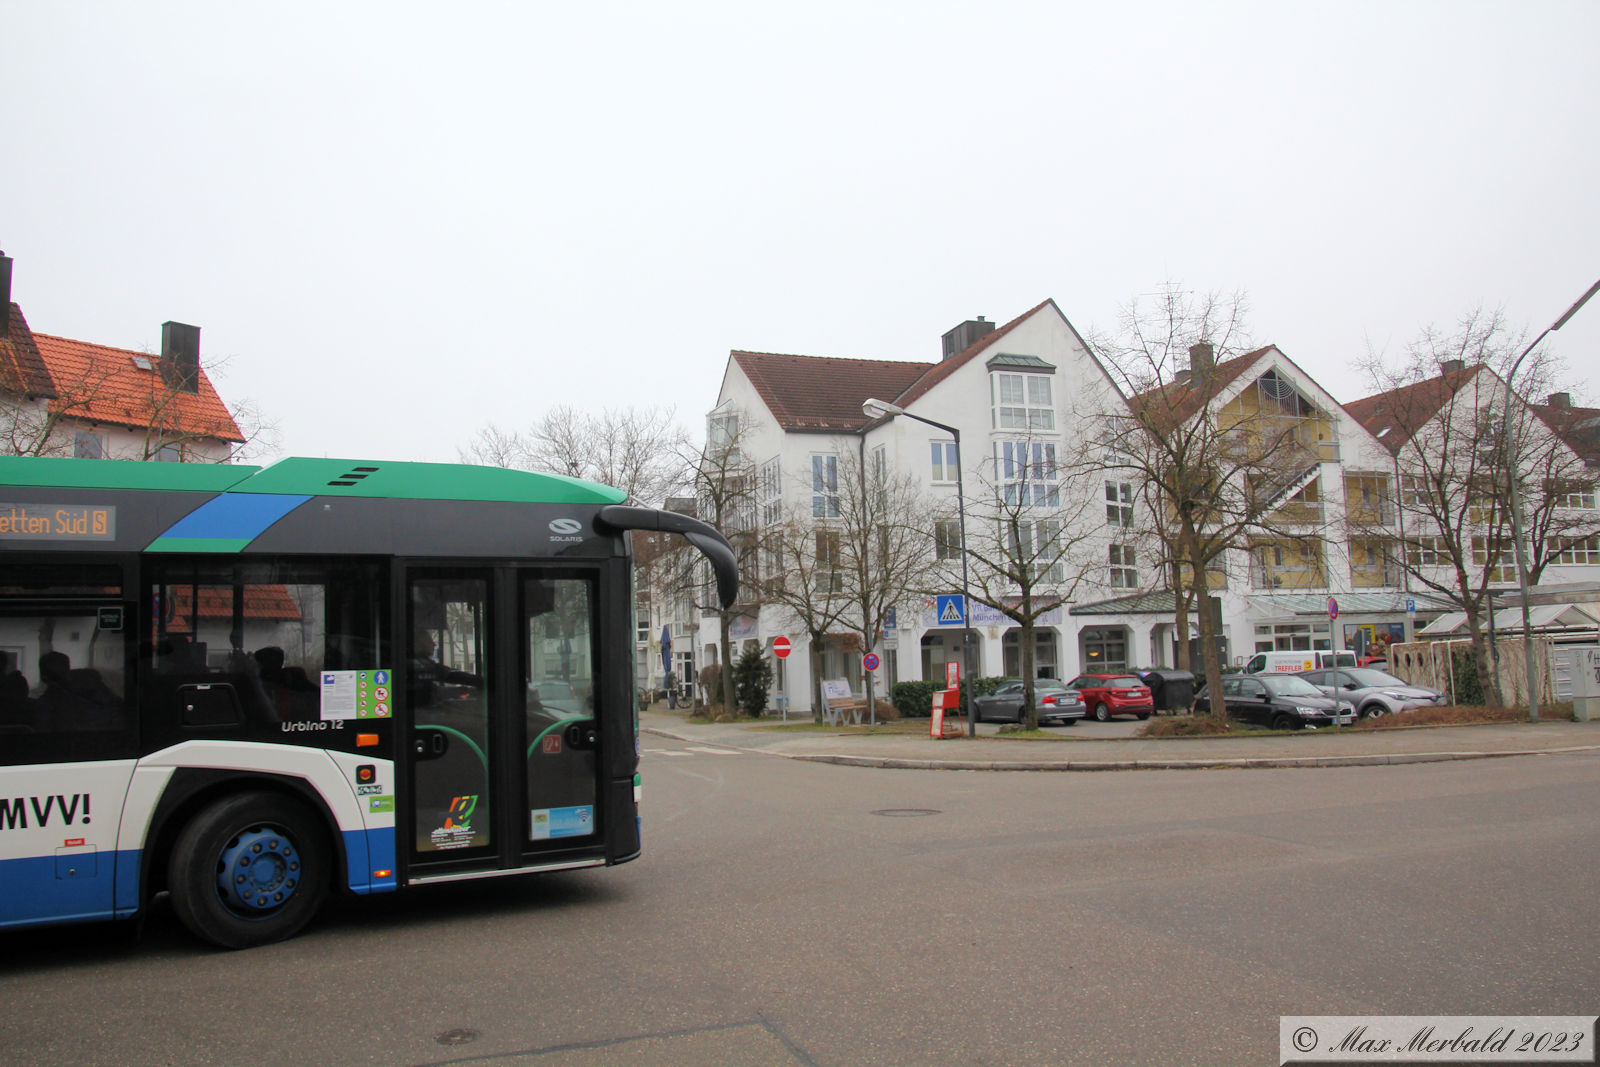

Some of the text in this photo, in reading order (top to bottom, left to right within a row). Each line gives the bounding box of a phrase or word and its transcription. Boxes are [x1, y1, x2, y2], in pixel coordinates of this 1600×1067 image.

[56, 509, 88, 534] Süd
[549, 535, 584, 543] SOLARIS
[1407, 600, 1414, 611] P
[281, 719, 345, 732] Urbino 12
[0, 793, 91, 830] MVV!
